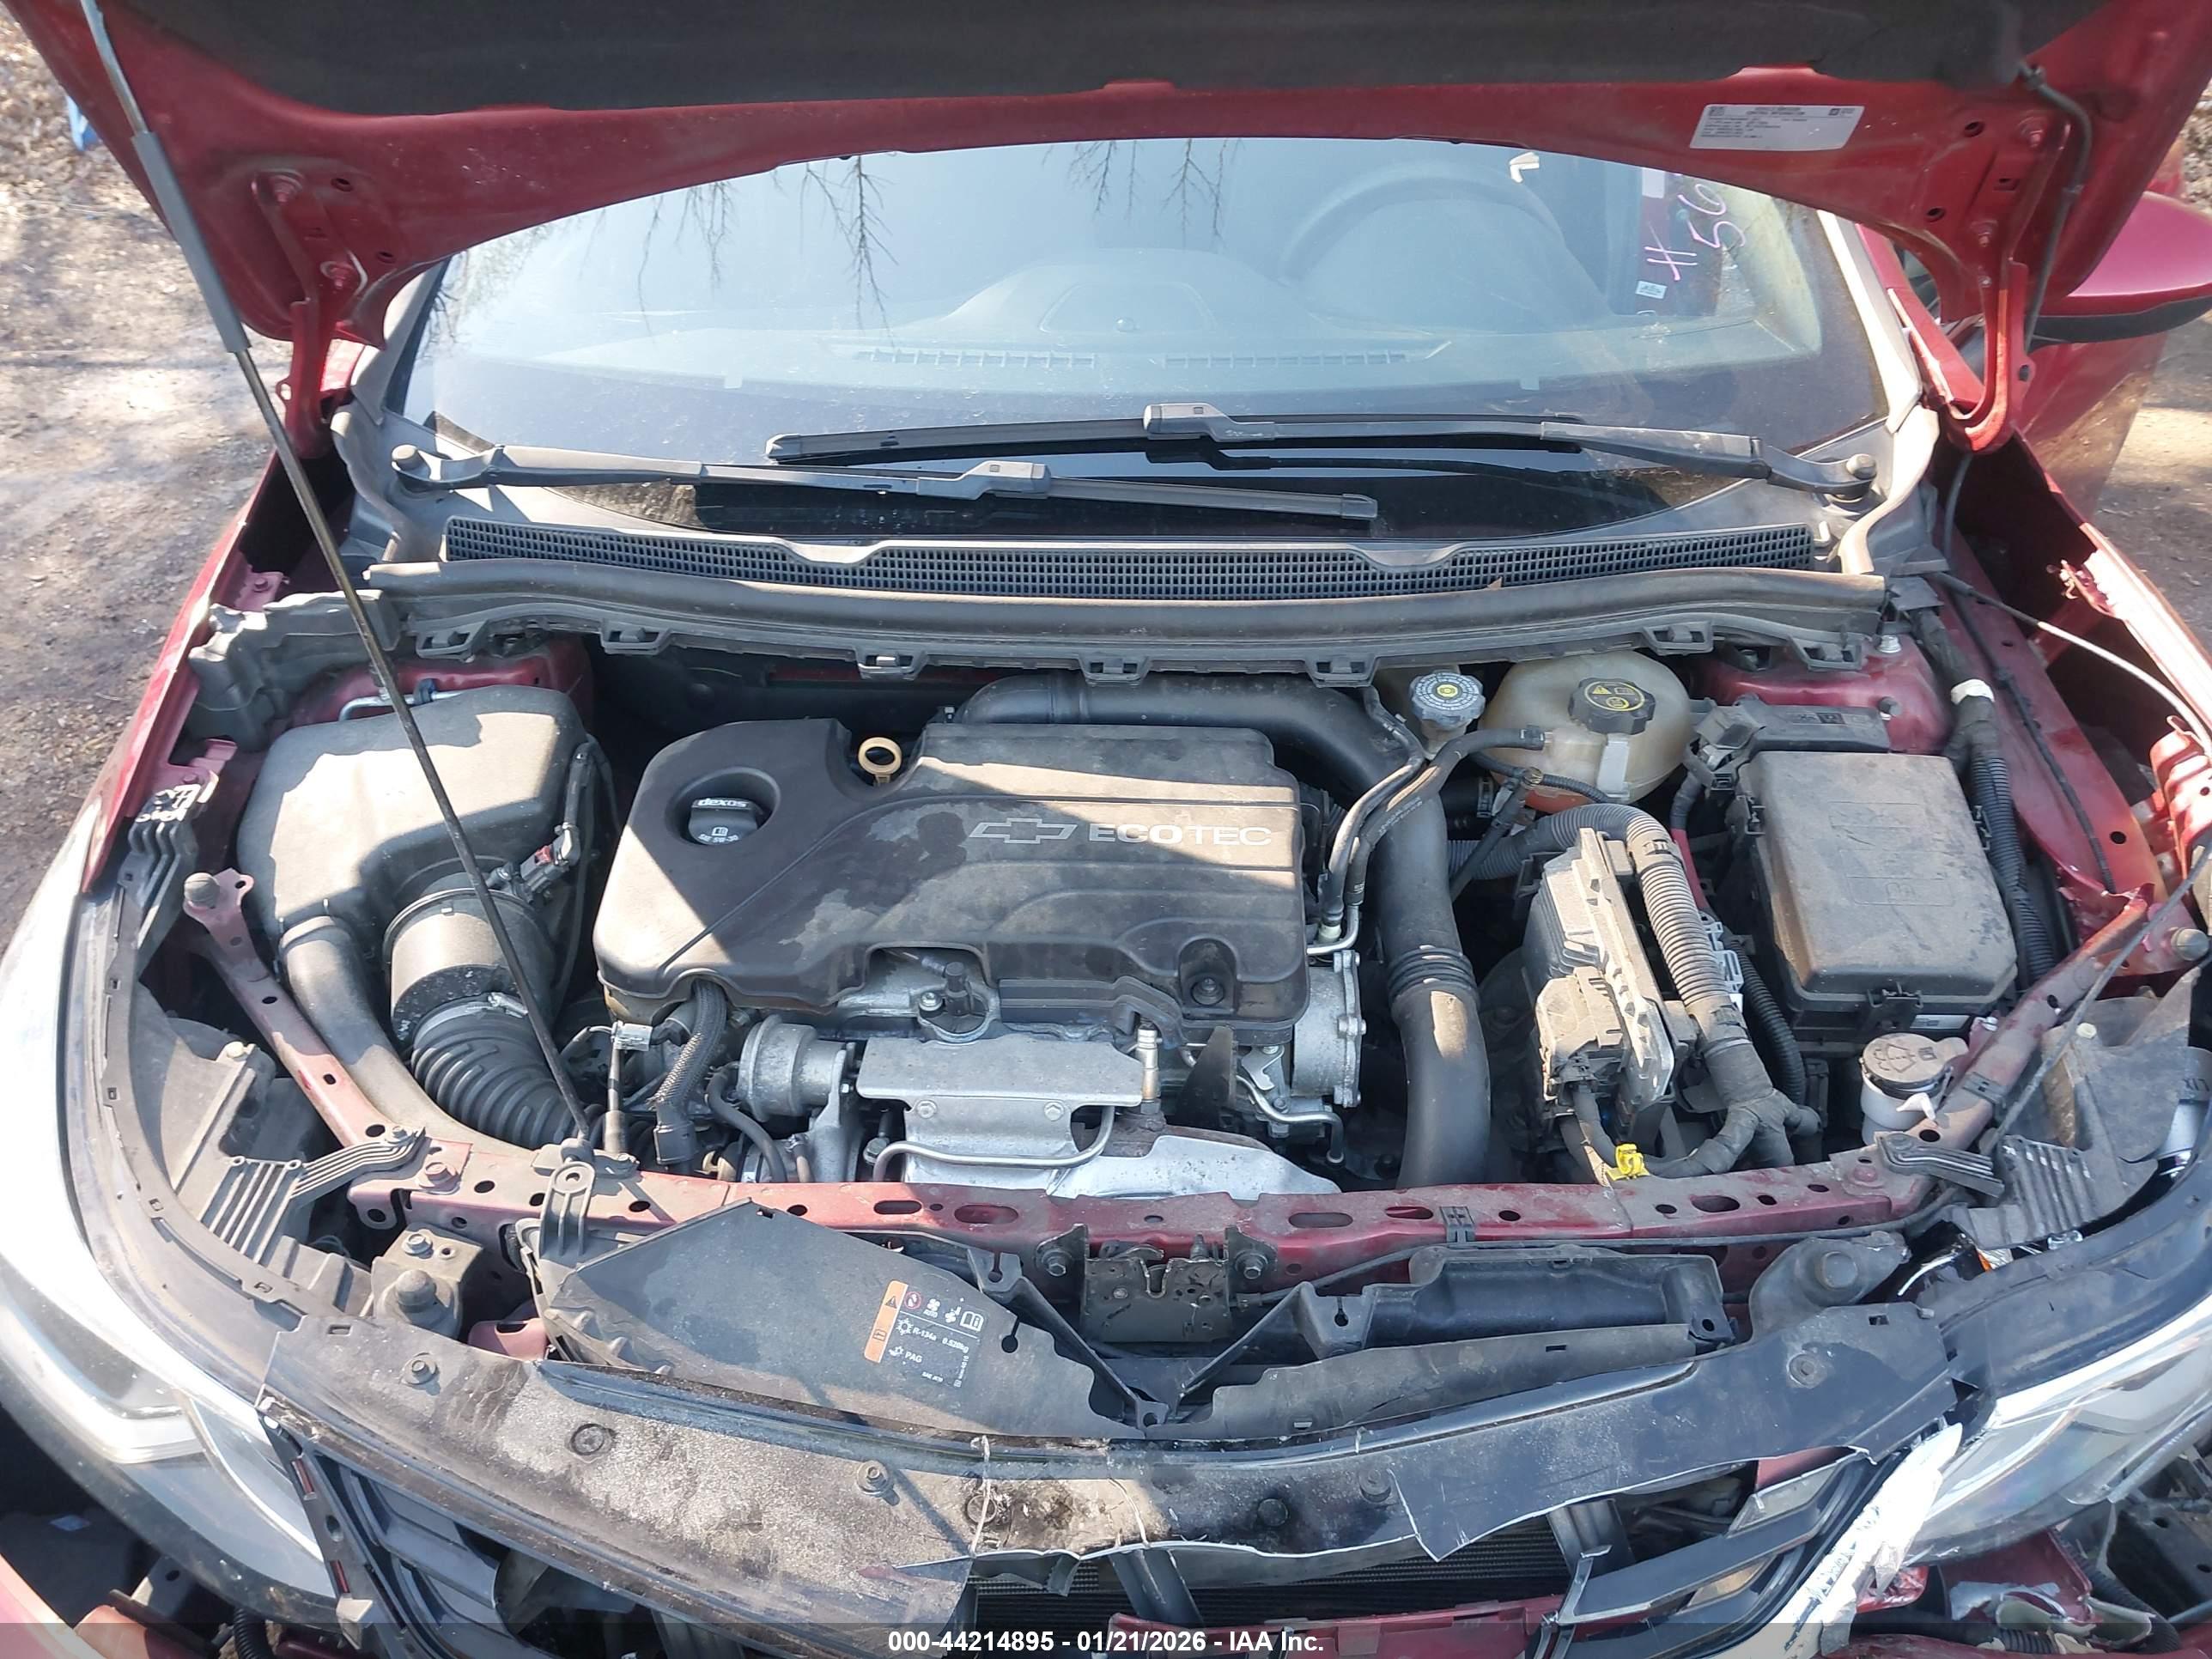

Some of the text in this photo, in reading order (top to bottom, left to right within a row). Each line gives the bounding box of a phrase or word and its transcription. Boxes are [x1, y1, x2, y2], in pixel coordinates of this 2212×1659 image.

[697, 798, 749, 807] dexos
[1089, 823, 1272, 846] ECOTEC
[912, 1327, 937, 1341] R-134a
[904, 1351, 922, 1363] PAG
